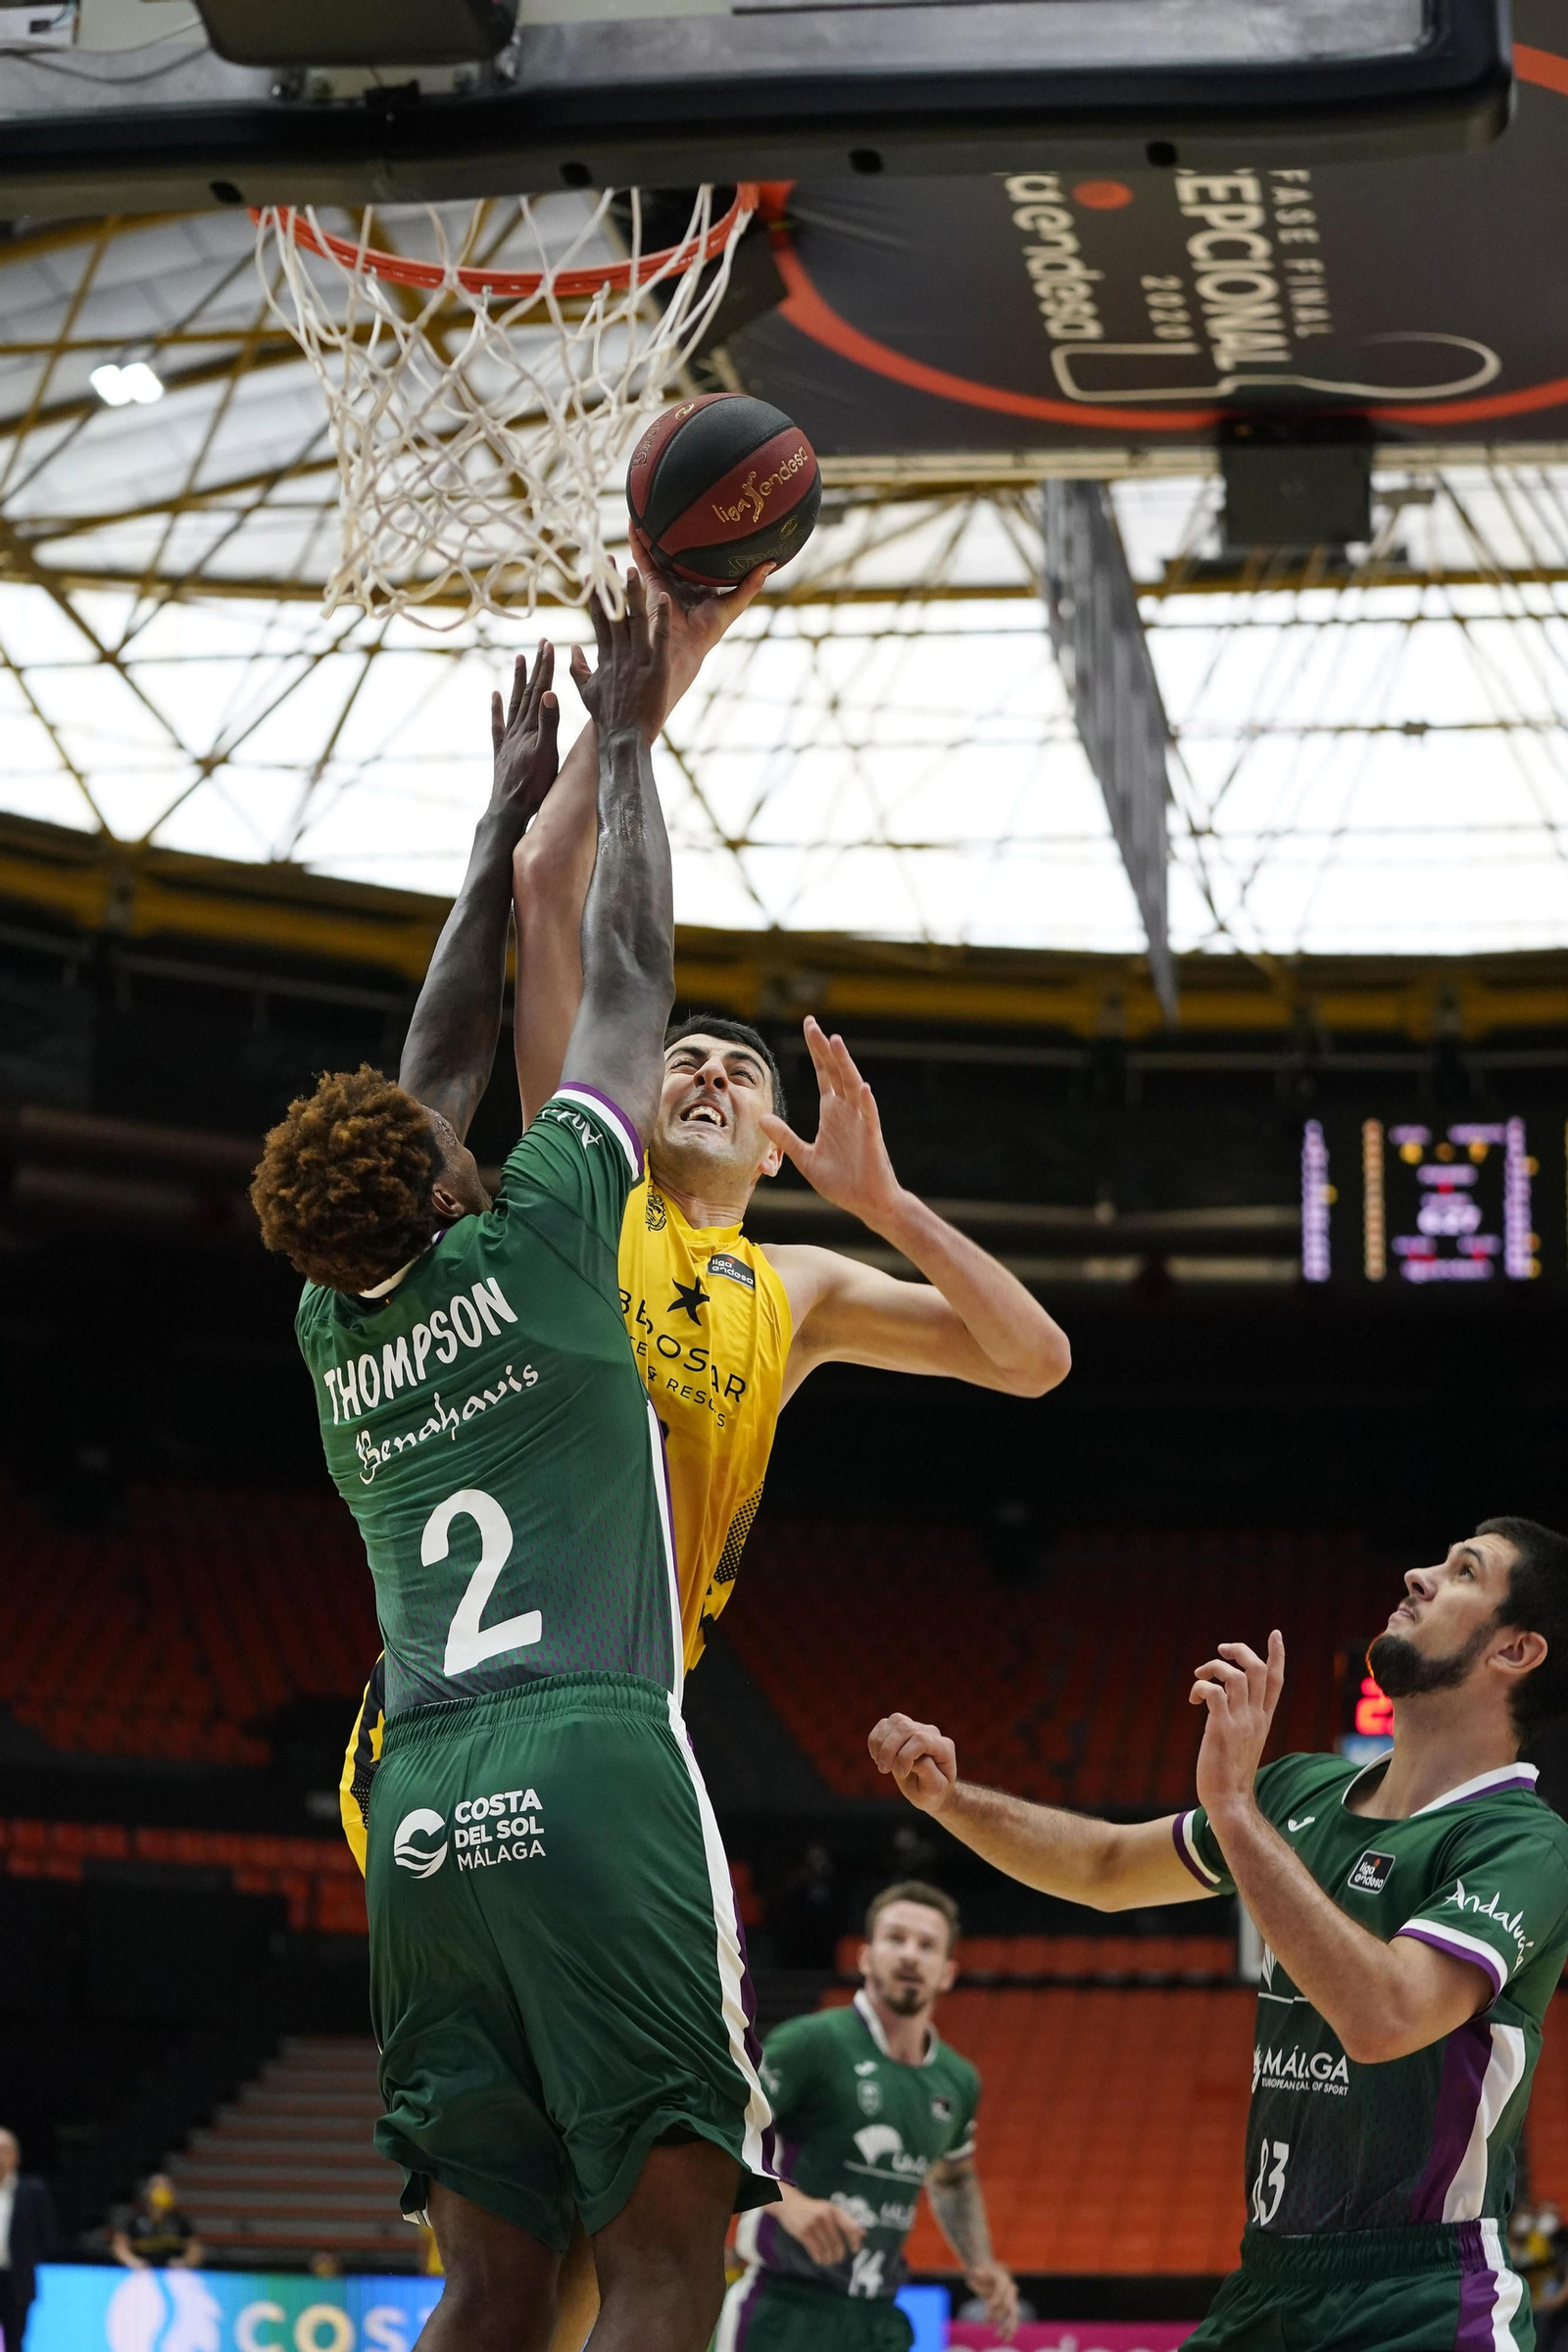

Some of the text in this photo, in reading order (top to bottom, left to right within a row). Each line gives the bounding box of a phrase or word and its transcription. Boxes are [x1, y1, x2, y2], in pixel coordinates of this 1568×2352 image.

[1175, 168, 1293, 371] EPCIONAL
[1269, 169, 1336, 337] FASE FINAL
[1141, 273, 1195, 340] 2020
[711, 445, 809, 523] liga endesa
[711, 1258, 733, 1268] liga
[711, 1265, 754, 1285] endesa
[323, 1277, 518, 1425] THOMPSON
[420, 1489, 543, 1677] 2
[454, 1788, 544, 1825] COSTA
[454, 1816, 545, 1849] DEL SOL
[457, 1839, 546, 1872] MÁLAGA
[1359, 1861, 1376, 1875] liga
[1311, 2081, 1324, 2091] OF
[1324, 2082, 1349, 2097] SPORT
[234, 2299, 435, 2352] COS
